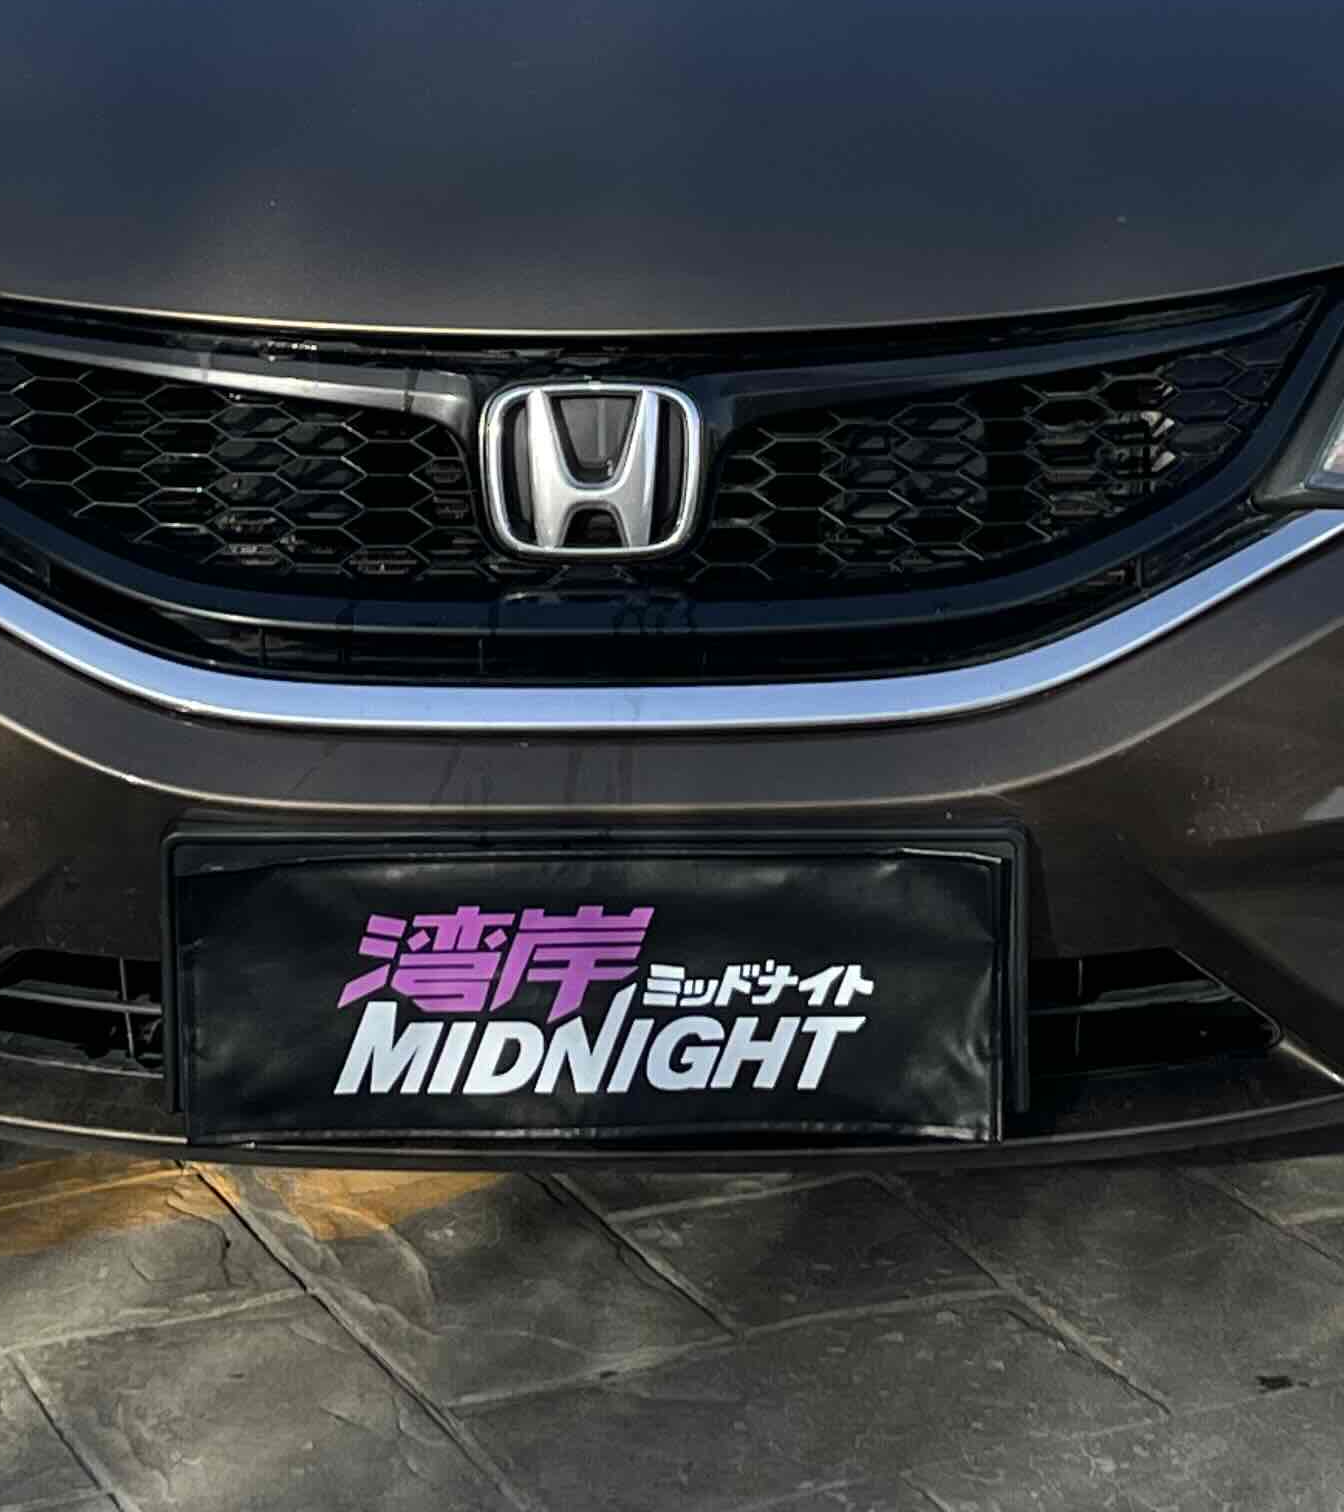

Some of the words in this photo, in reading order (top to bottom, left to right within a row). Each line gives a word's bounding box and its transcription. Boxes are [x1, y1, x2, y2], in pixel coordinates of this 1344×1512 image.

[337, 905, 655, 1023] 湾岸
[643, 959, 876, 1009] ミッドナイト
[334, 983, 868, 1096] MIDNIGHT
